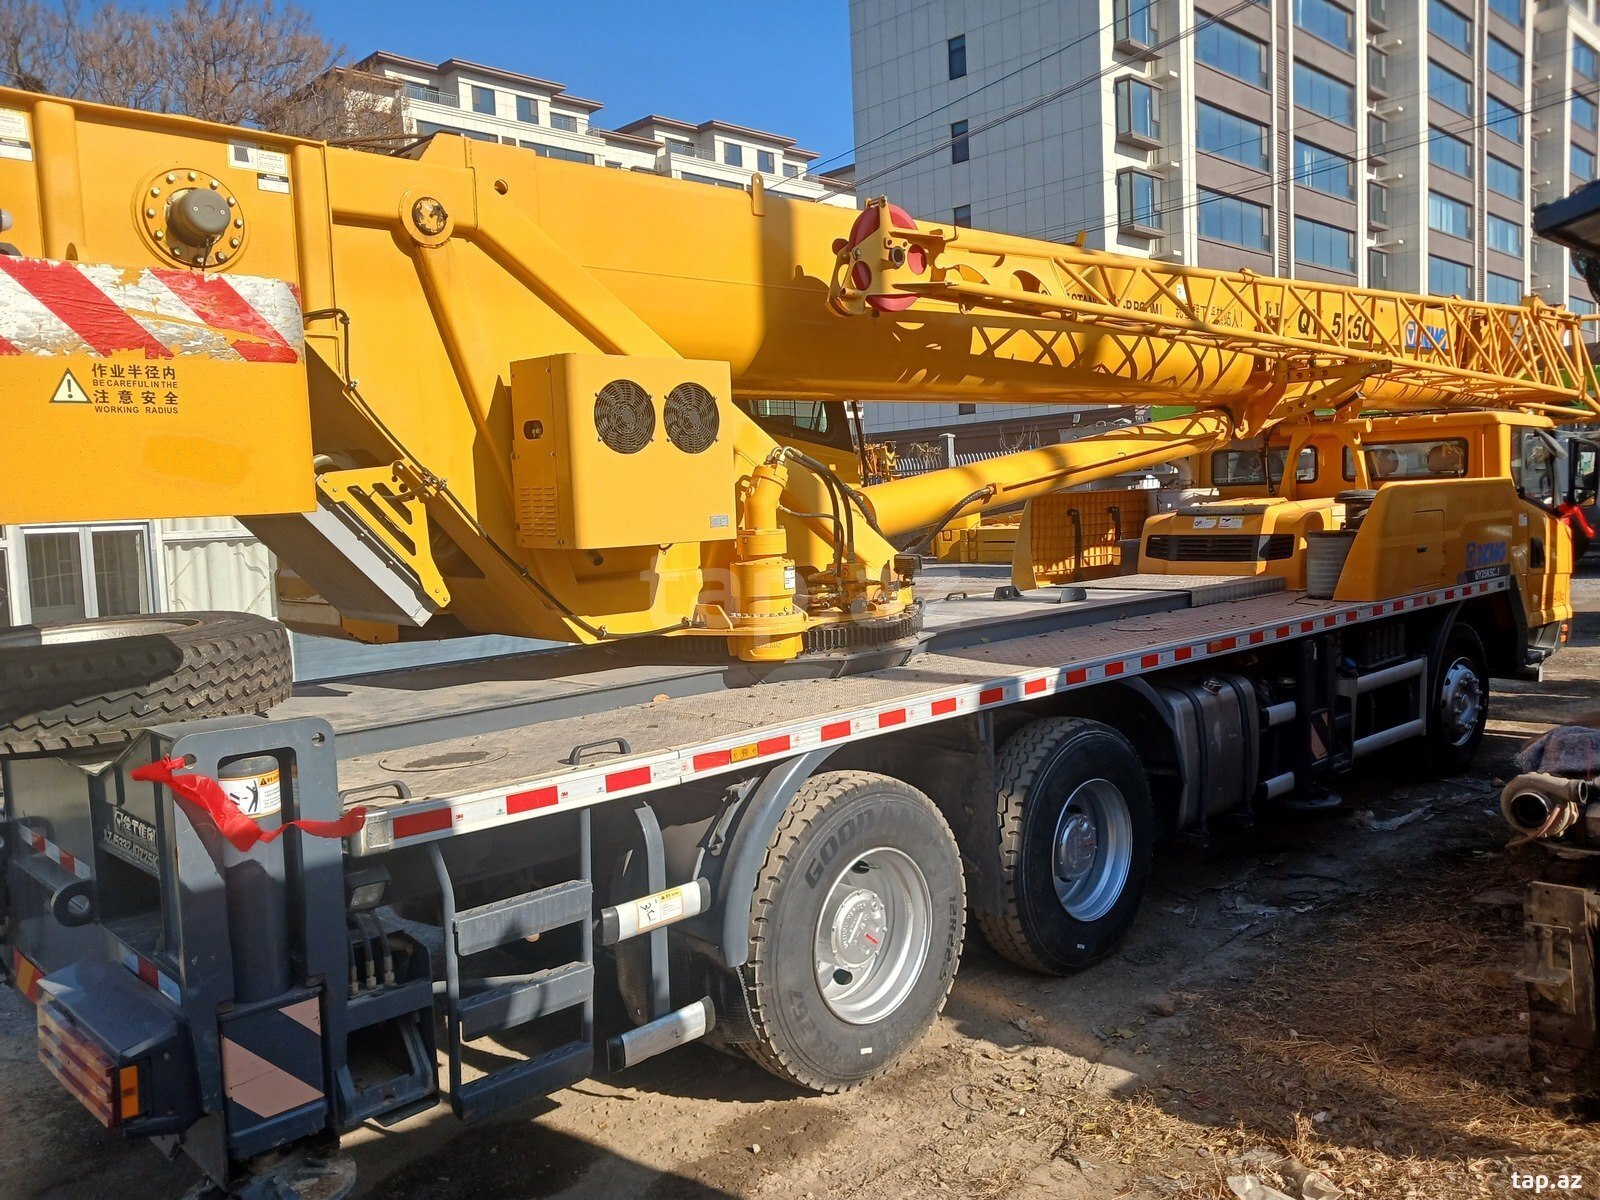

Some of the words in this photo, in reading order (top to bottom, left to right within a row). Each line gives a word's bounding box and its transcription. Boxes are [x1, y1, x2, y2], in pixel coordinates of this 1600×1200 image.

[91, 363, 176, 380] 作业半径内
[106, 380, 149, 388] CAREFUL
[160, 381, 178, 389] THE
[93, 389, 179, 405] 注意安全
[94, 405, 139, 414] WORKING
[145, 406, 179, 414] RADIUS
